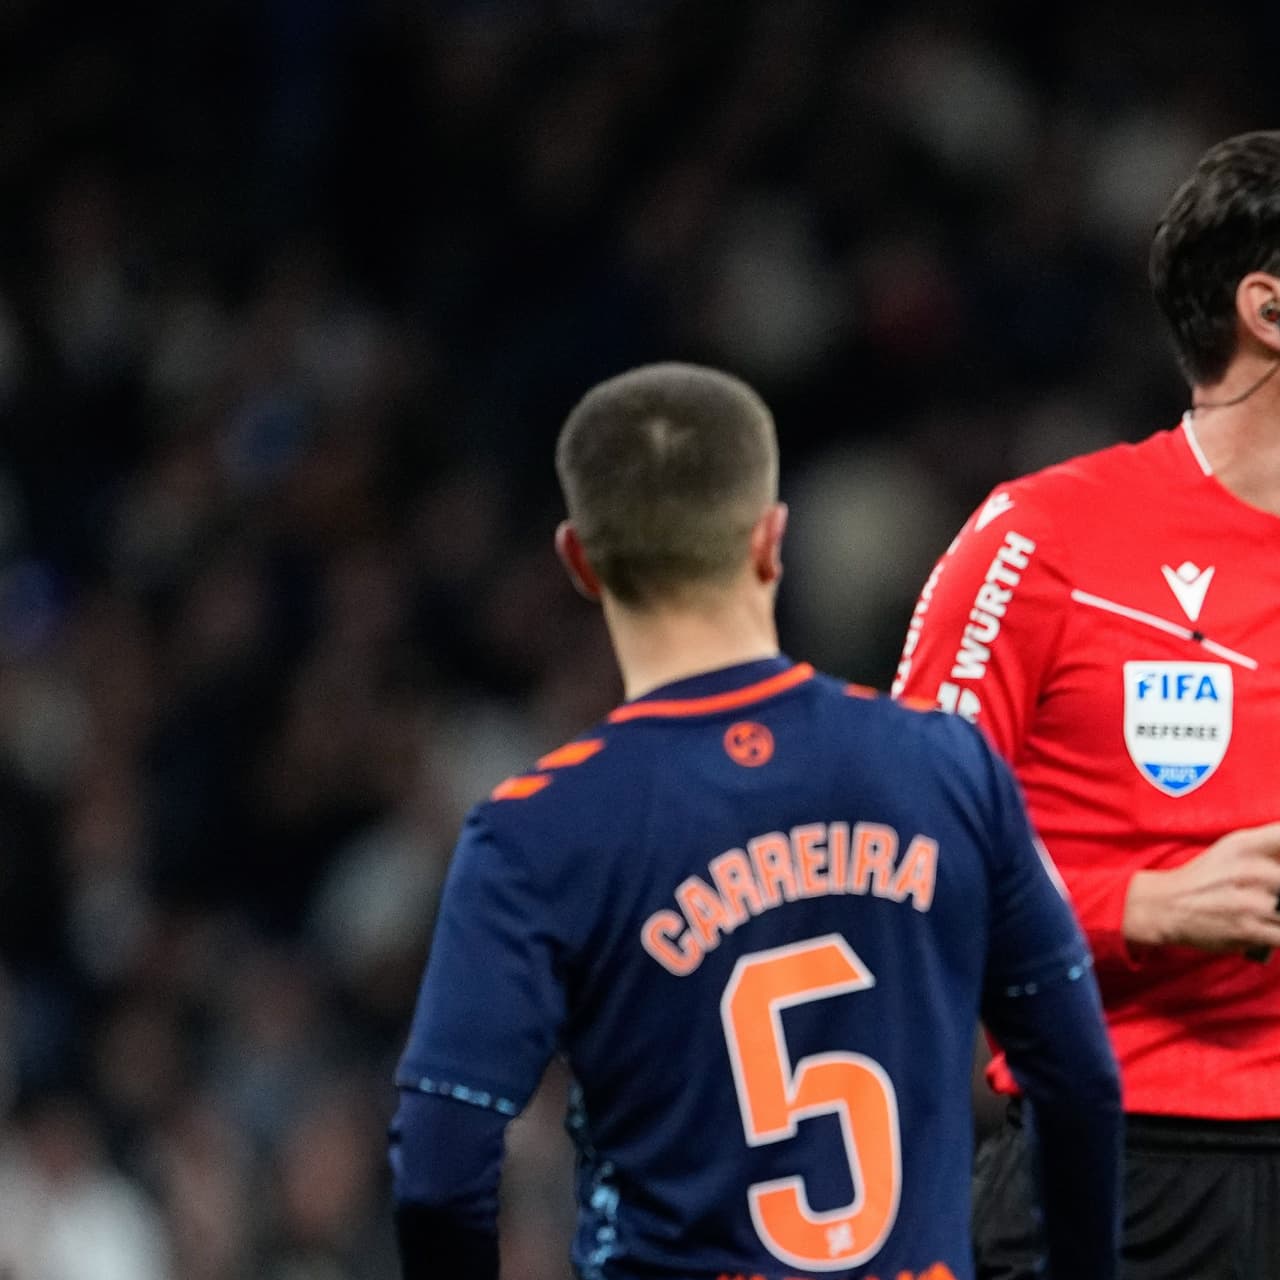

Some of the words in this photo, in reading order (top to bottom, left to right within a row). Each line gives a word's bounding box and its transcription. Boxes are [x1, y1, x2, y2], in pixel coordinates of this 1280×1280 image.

[950, 530, 1036, 680] WÜRTH
[1137, 673, 1218, 700] FIFA
[640, 820, 940, 977] CARREIRA
[720, 932, 902, 1273] 5
